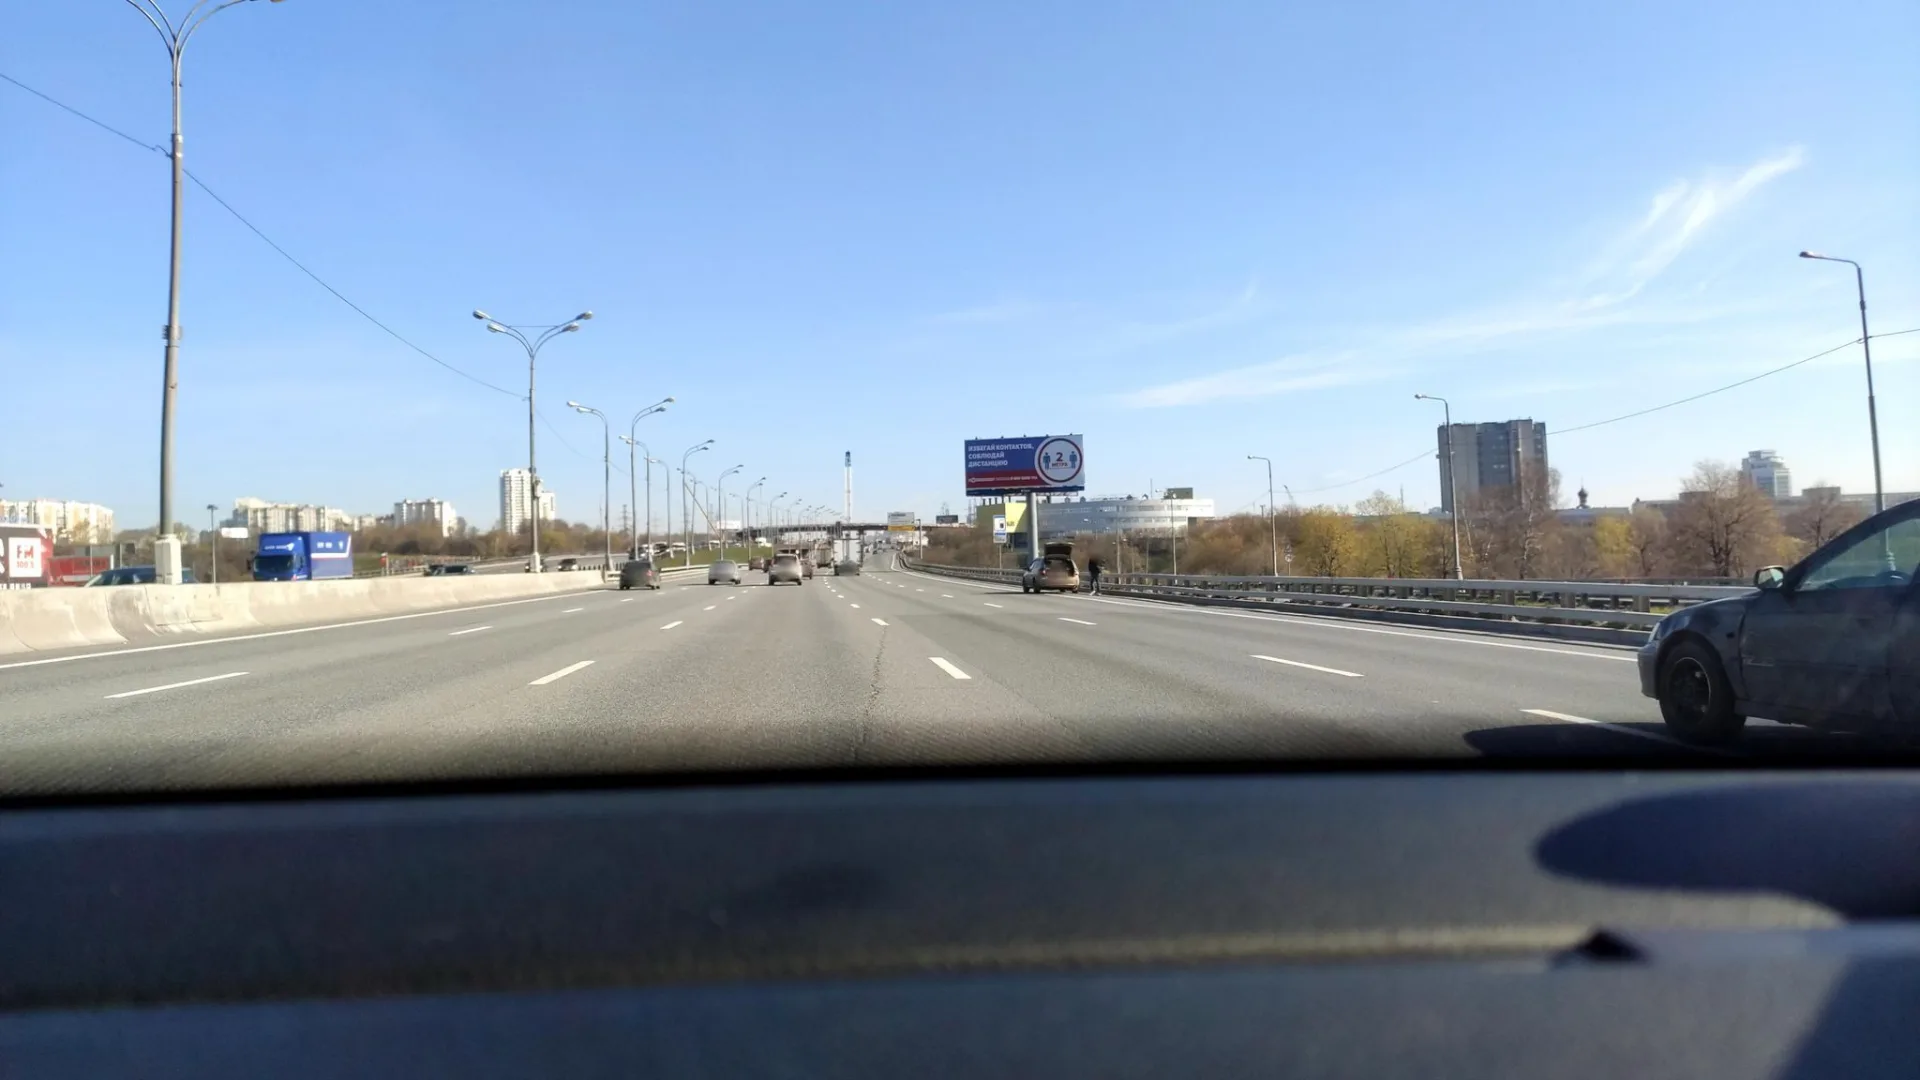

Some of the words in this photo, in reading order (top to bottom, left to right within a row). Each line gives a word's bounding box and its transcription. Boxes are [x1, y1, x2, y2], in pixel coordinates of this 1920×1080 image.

[968, 451, 1004, 459] СОБЛЮДАЙ
[1056, 452, 1063, 461] 2
[968, 460, 1008, 468] ДИСТАНЦИЮ
